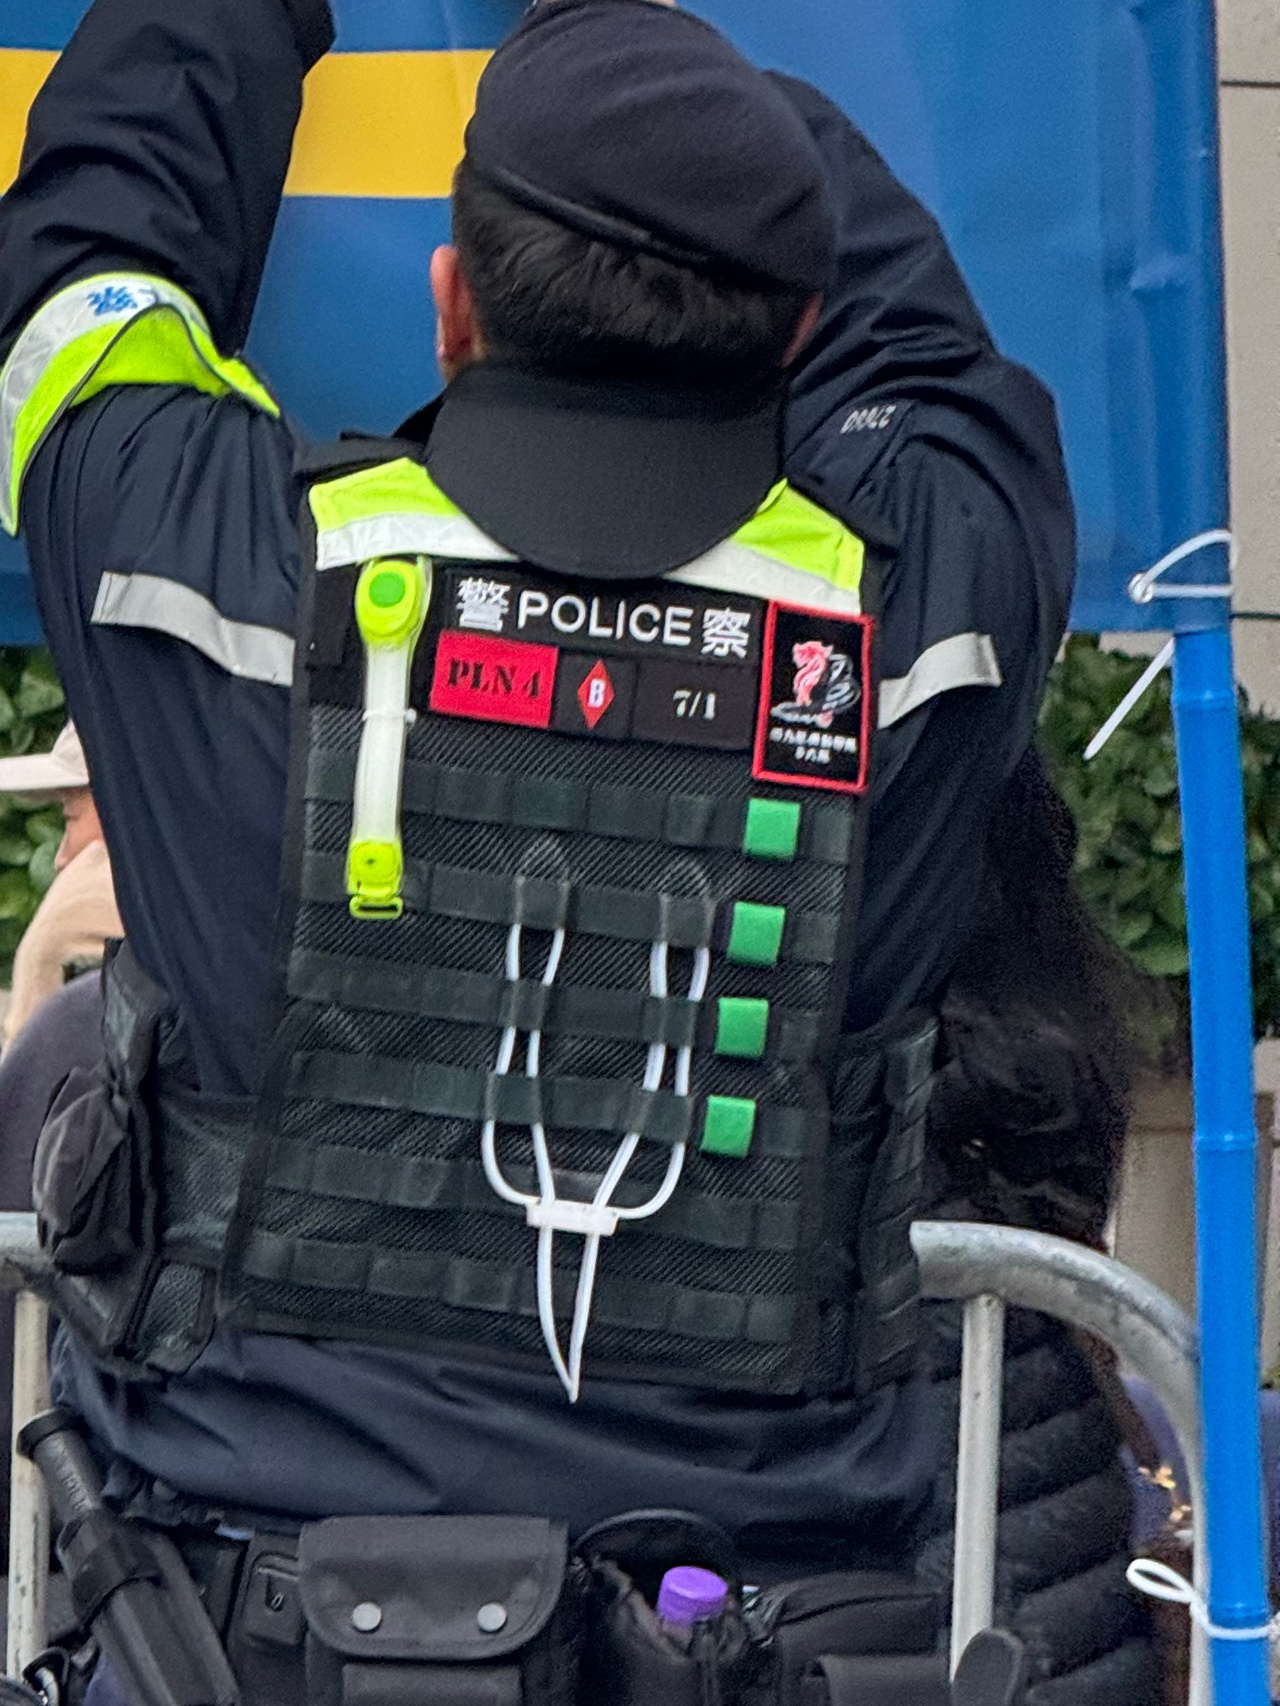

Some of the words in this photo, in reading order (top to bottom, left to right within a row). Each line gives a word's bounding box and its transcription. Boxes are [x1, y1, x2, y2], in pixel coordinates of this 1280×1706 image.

[457, 577, 510, 633] 警
[518, 590, 693, 646] POLICE
[701, 607, 751, 659] 察
[448, 657, 517, 696] PLN
[587, 678, 606, 708] B
[673, 687, 716, 720] 7/1
